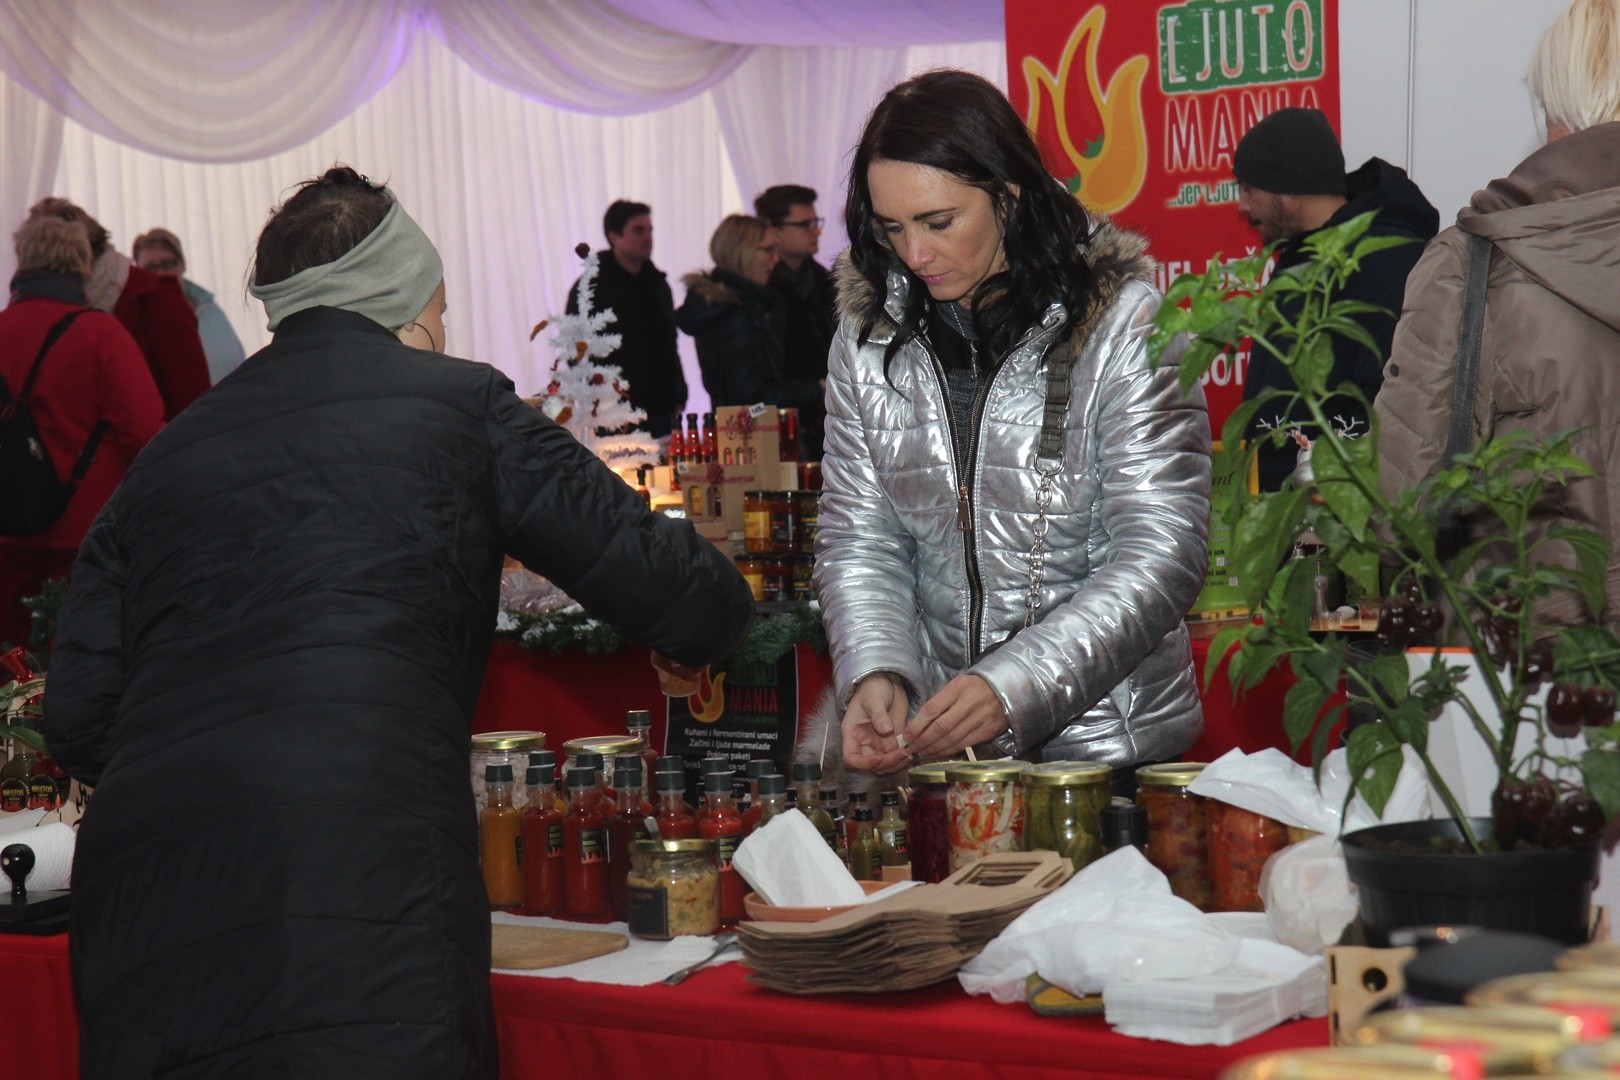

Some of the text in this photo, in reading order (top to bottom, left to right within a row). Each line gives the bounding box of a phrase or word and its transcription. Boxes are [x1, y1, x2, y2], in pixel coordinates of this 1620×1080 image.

[1166, 0, 1313, 83] LJUTO
[730, 687, 778, 713] MANIA
[684, 727, 708, 736] Kuhani
[712, 728, 756, 739] fermentirani
[732, 742, 771, 751] marmelade
[730, 752, 751, 761] paketi
